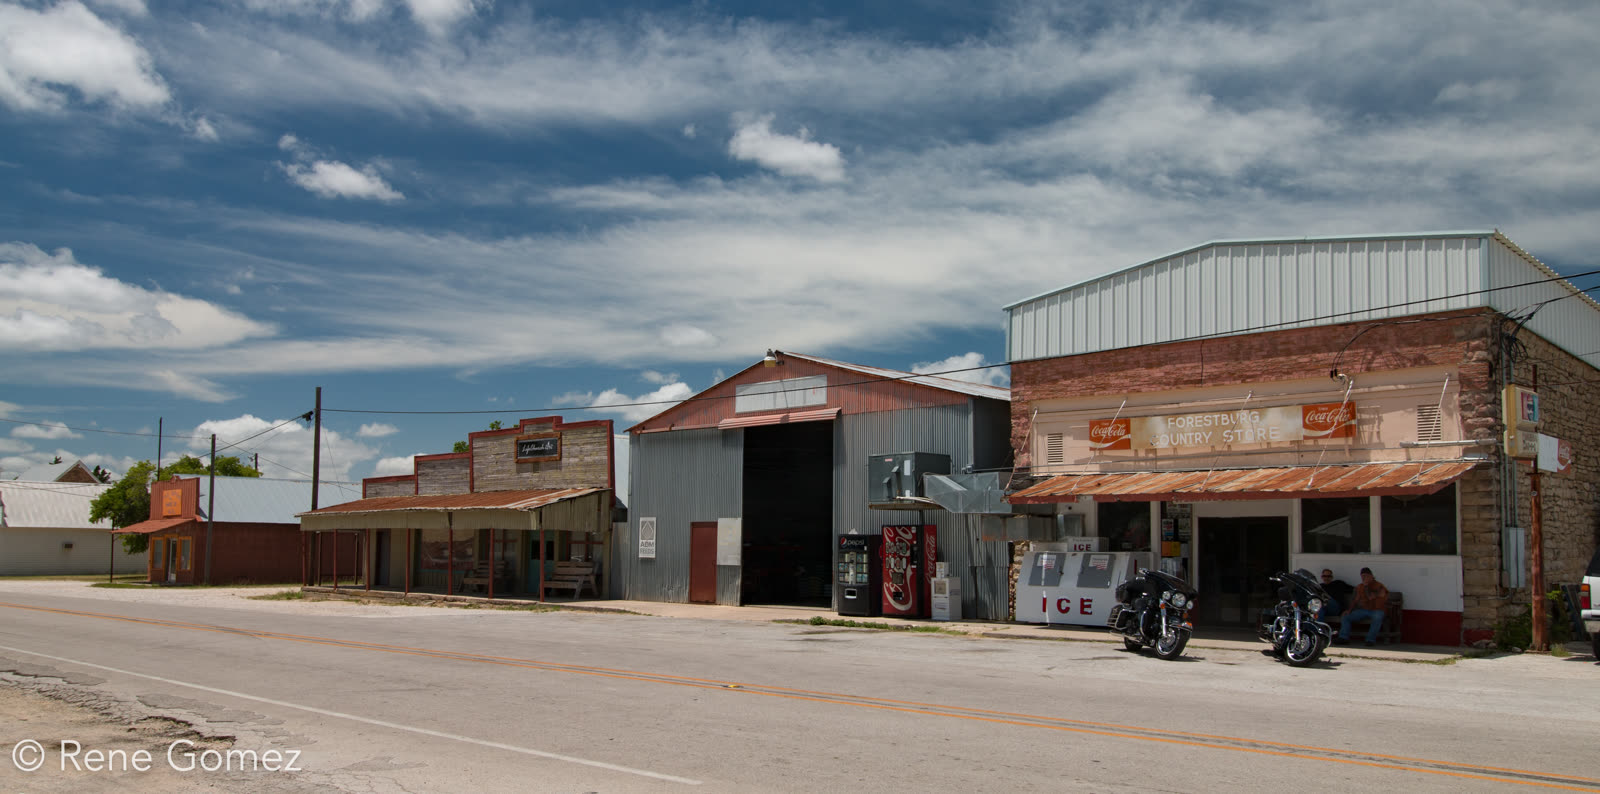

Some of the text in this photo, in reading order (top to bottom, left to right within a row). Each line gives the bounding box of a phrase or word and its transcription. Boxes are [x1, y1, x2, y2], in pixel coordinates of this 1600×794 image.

[1168, 411, 1259, 428] FORESTBURG
[1223, 426, 1280, 442] STORE
[1073, 543, 1092, 552] ICE
[1042, 597, 1093, 616] ICE
